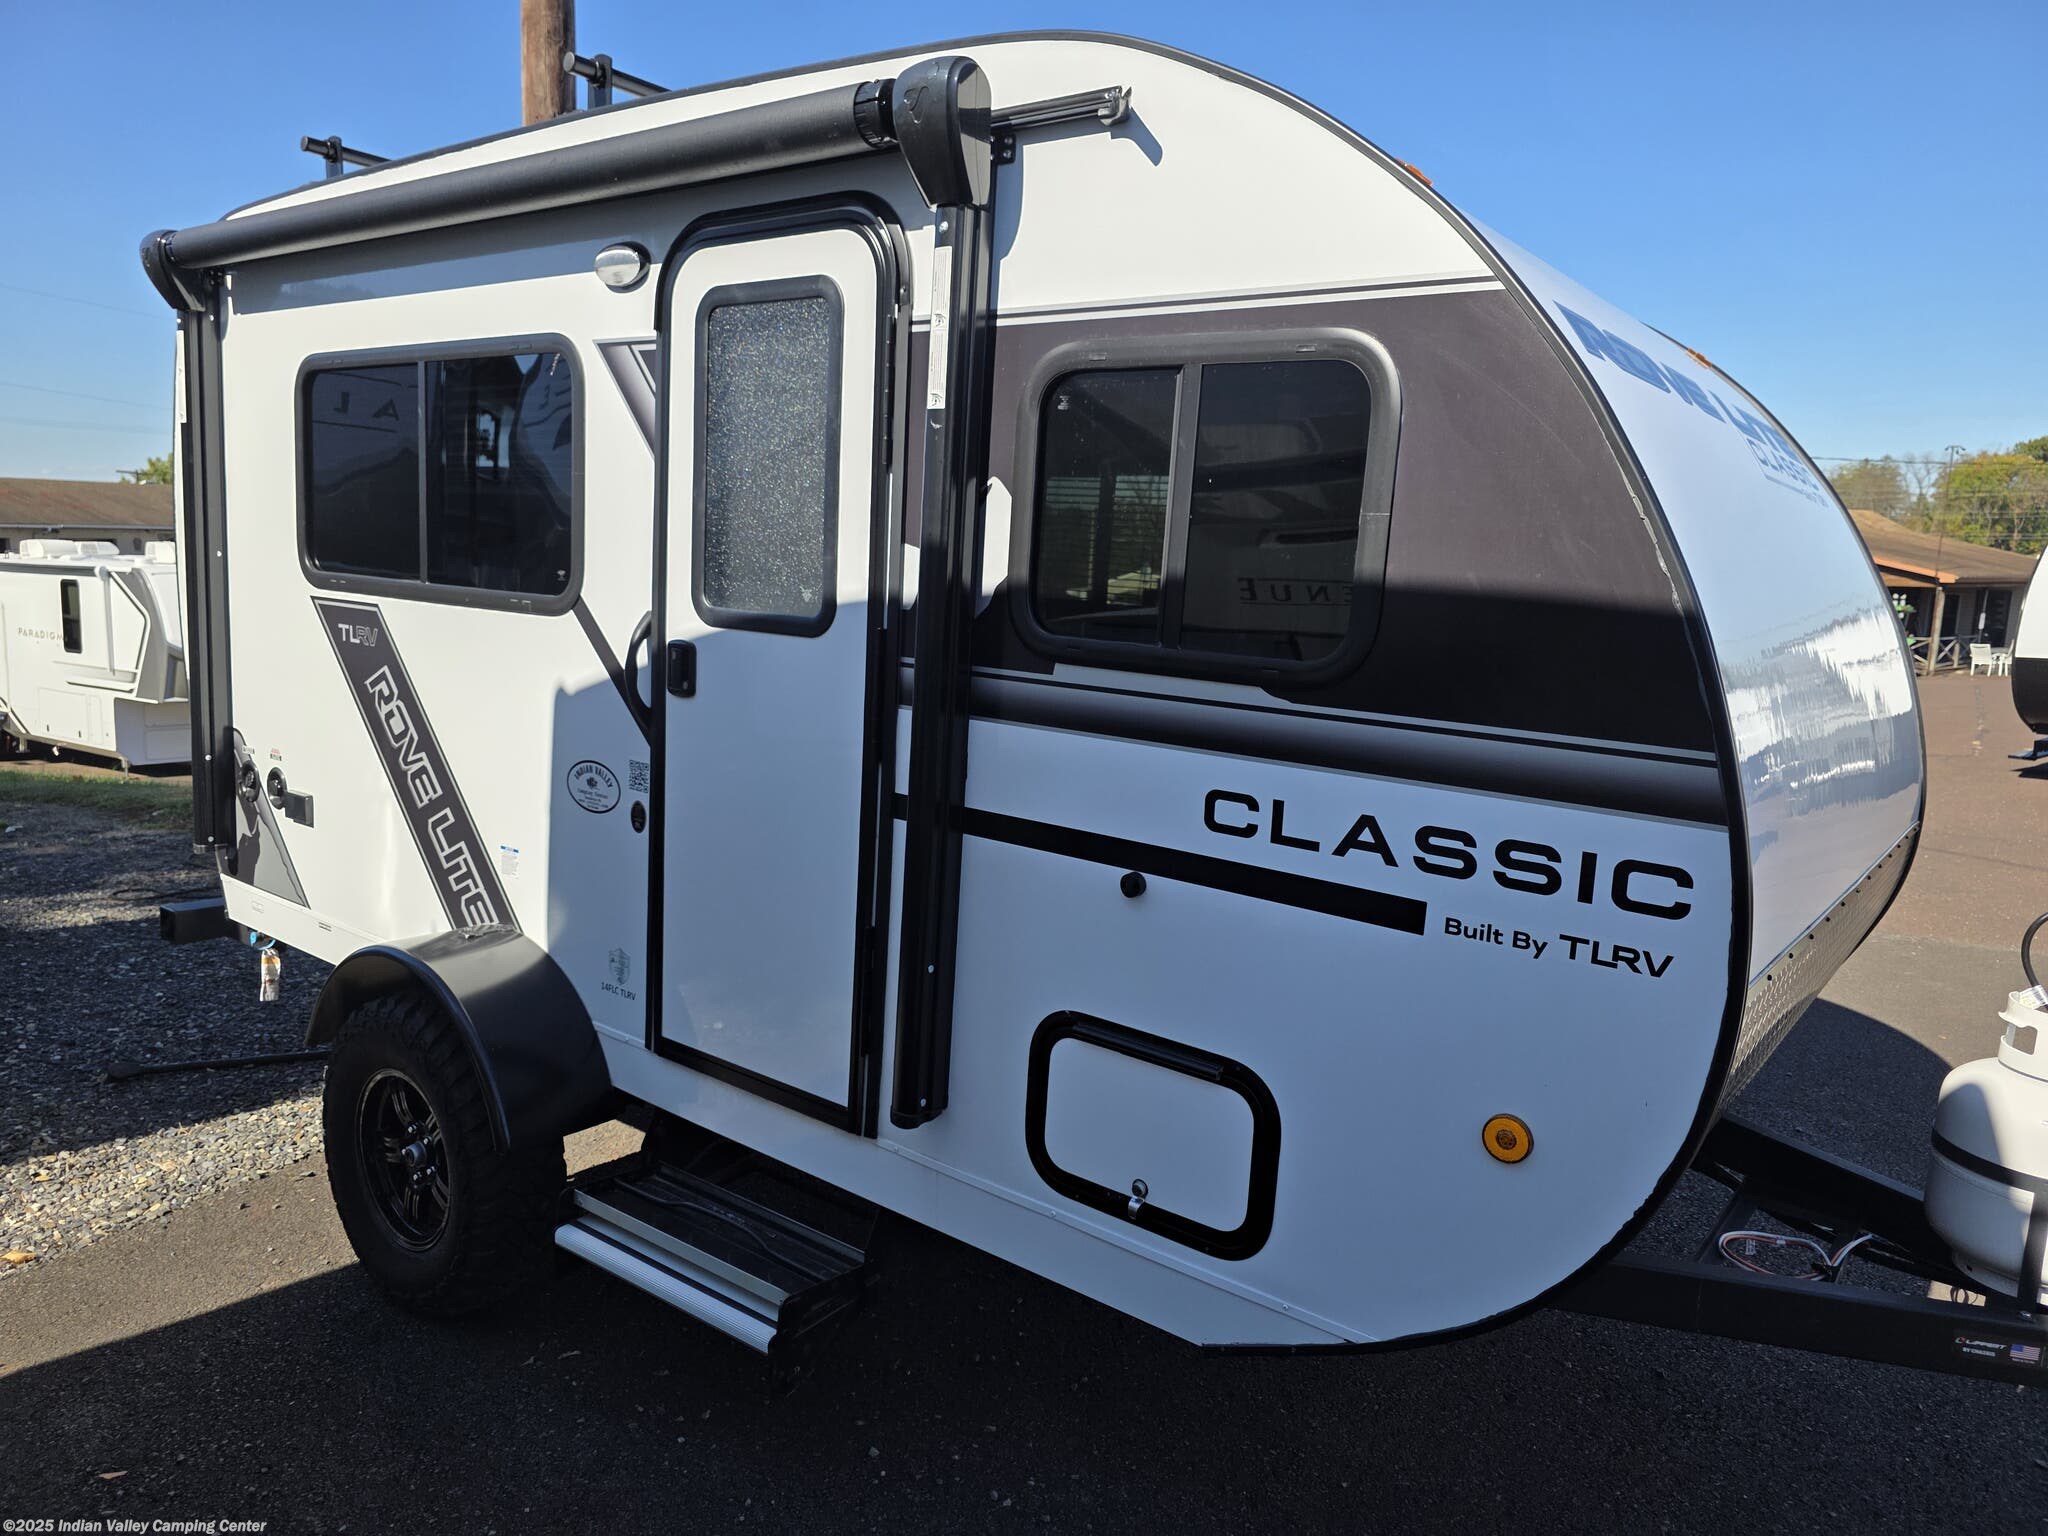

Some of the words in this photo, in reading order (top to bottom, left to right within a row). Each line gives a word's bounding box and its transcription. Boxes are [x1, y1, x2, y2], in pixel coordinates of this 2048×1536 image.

[338, 623, 379, 646] TLRV
[364, 664, 443, 809] ROVE
[428, 806, 499, 928] LITE
[1203, 788, 1695, 921] CLASSIC
[1444, 916, 1504, 946] Built
[1511, 930, 1548, 959] By
[1558, 933, 1674, 978] TLRV
